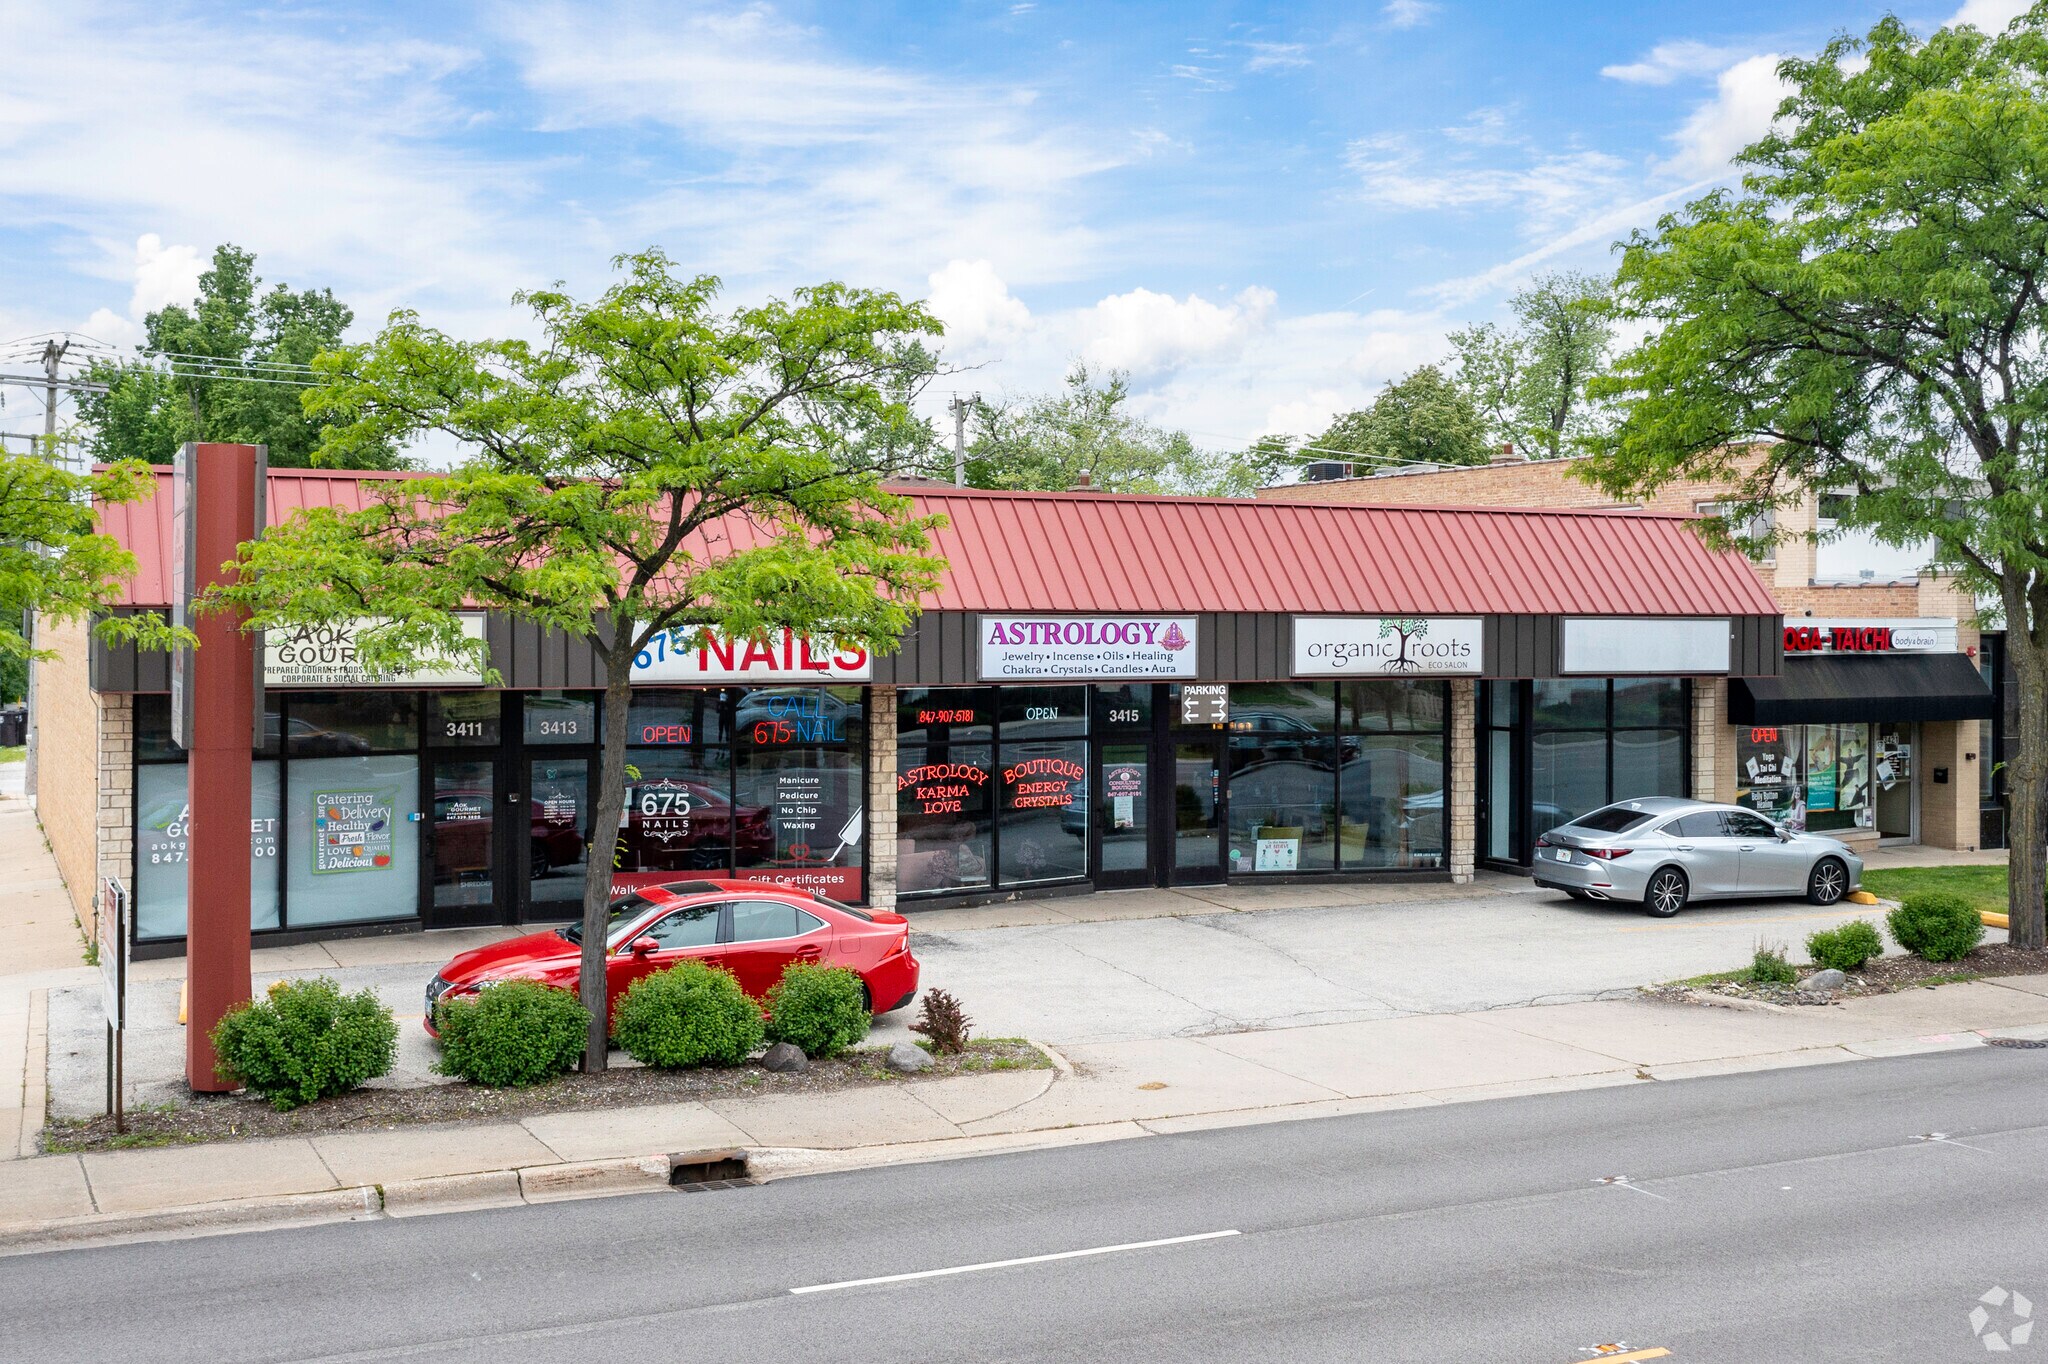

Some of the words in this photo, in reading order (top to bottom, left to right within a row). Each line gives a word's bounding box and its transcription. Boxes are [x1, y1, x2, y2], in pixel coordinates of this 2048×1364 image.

[987, 621, 1160, 645] ASTROLOGY
[1784, 626, 1823, 650] OGA
[699, 626, 867, 671] NAILS
[1308, 642, 1394, 668] organic
[1412, 638, 1471, 657] roots
[1002, 652, 1044, 663] Jewelry
[1053, 652, 1095, 661] Incense
[1102, 651, 1124, 661] Oils
[1132, 651, 1174, 662] Healing
[1002, 664, 1042, 674] Chakra
[1050, 664, 1093, 676] Crystals
[1101, 664, 1143, 674] Candles
[1151, 665, 1176, 673] Aura
[1428, 661, 1442, 669] ECO
[1444, 661, 1468, 669] SALON
[281, 675, 324, 683] CORPORATE
[361, 674, 396, 682] CATRING
[1184, 685, 1226, 695] PARKING
[767, 696, 828, 719] CALL
[1026, 707, 1059, 720] OPEN
[919, 710, 974, 723] 847-907-5181
[1109, 709, 1139, 722] 3415
[446, 722, 482, 736] 3411
[540, 721, 577, 735] 3413
[643, 726, 691, 743] OPEN
[754, 720, 846, 744] 675-NAIL
[1751, 727, 1778, 743] OPEN
[1762, 753, 1775, 762] Yoga
[897, 763, 989, 791] ASTROLOGY
[1003, 758, 1084, 784] BOUTIQUE
[1754, 775, 1782, 784] Meditation
[916, 784, 970, 799] KARMA
[1018, 781, 1069, 795] ENERGY
[317, 793, 374, 805] Catering
[641, 793, 691, 816] 675
[1014, 794, 1073, 808] CRYSTALS
[796, 806, 817, 814] Chip
[924, 800, 961, 814] LOVE
[340, 804, 391, 826] Delivery
[328, 820, 371, 832] Healthy
[642, 820, 689, 828] NAILS
[783, 821, 816, 830] Waxing
[318, 828, 326, 870] gourmet
[327, 847, 352, 856] LOVE
[328, 857, 373, 869] Delicious
[775, 873, 845, 884] Certificates
